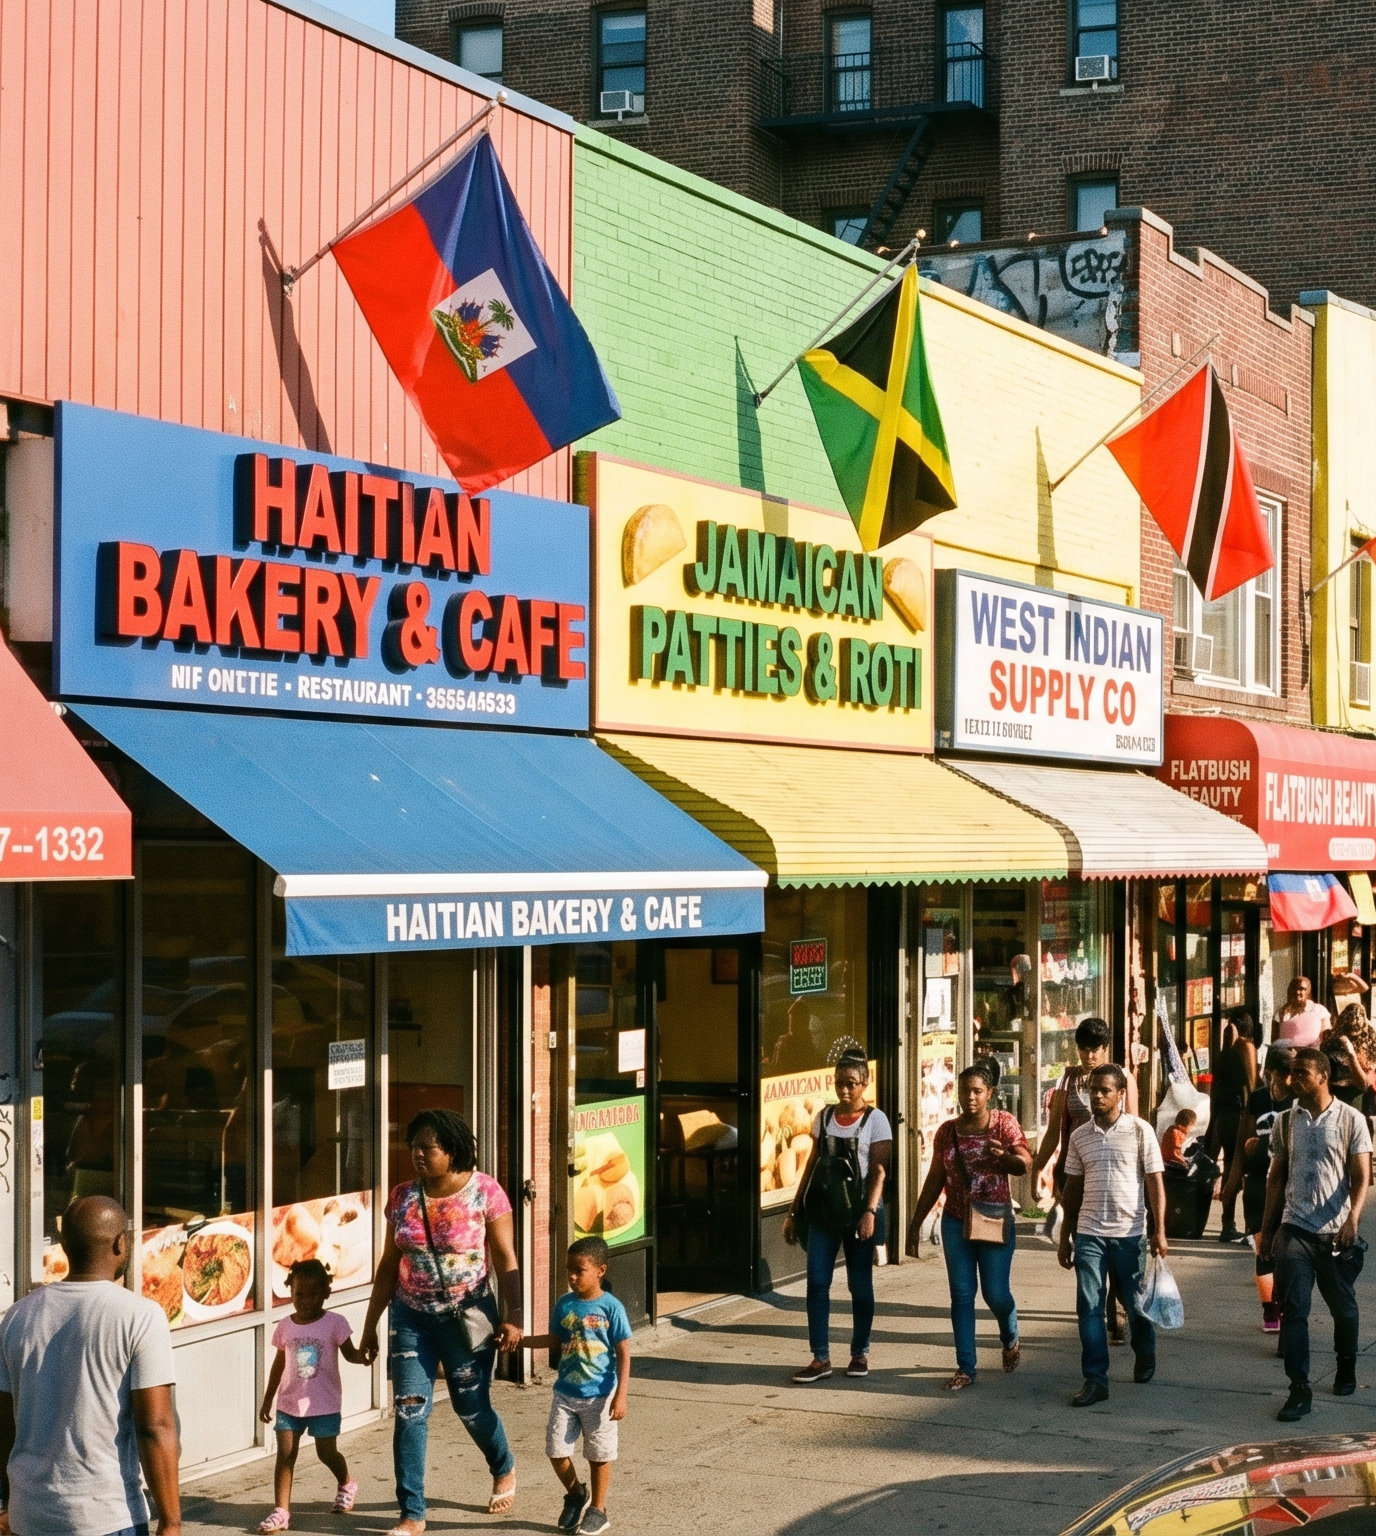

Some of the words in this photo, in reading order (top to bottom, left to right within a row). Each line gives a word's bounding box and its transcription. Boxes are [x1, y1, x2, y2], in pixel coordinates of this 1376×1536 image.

[252, 452, 490, 576] HAITIAN
[694, 520, 883, 621] JAMAICAN
[117, 541, 382, 660] BAKERY
[399, 581, 441, 667] &
[458, 590, 586, 680] CAFE
[971, 590, 1055, 657] WEST
[1065, 610, 1152, 674] INDIAN
[297, 675, 412, 707] RESTAURANT
[642, 605, 802, 697] PATTIES
[814, 631, 838, 702] &
[849, 637, 922, 710] ROTI
[989, 660, 1095, 721] SUPPLY
[1103, 678, 1137, 727] CO
[1171, 760, 1250, 781] FLATBUSH
[1265, 771, 1331, 826] FLATBUSH
[386, 901, 502, 941] HAITIAN
[512, 898, 613, 936] BAKERY
[620, 897, 636, 931] &
[644, 895, 702, 931] CAFE
[764, 1075, 821, 1103] JAMAICAN
